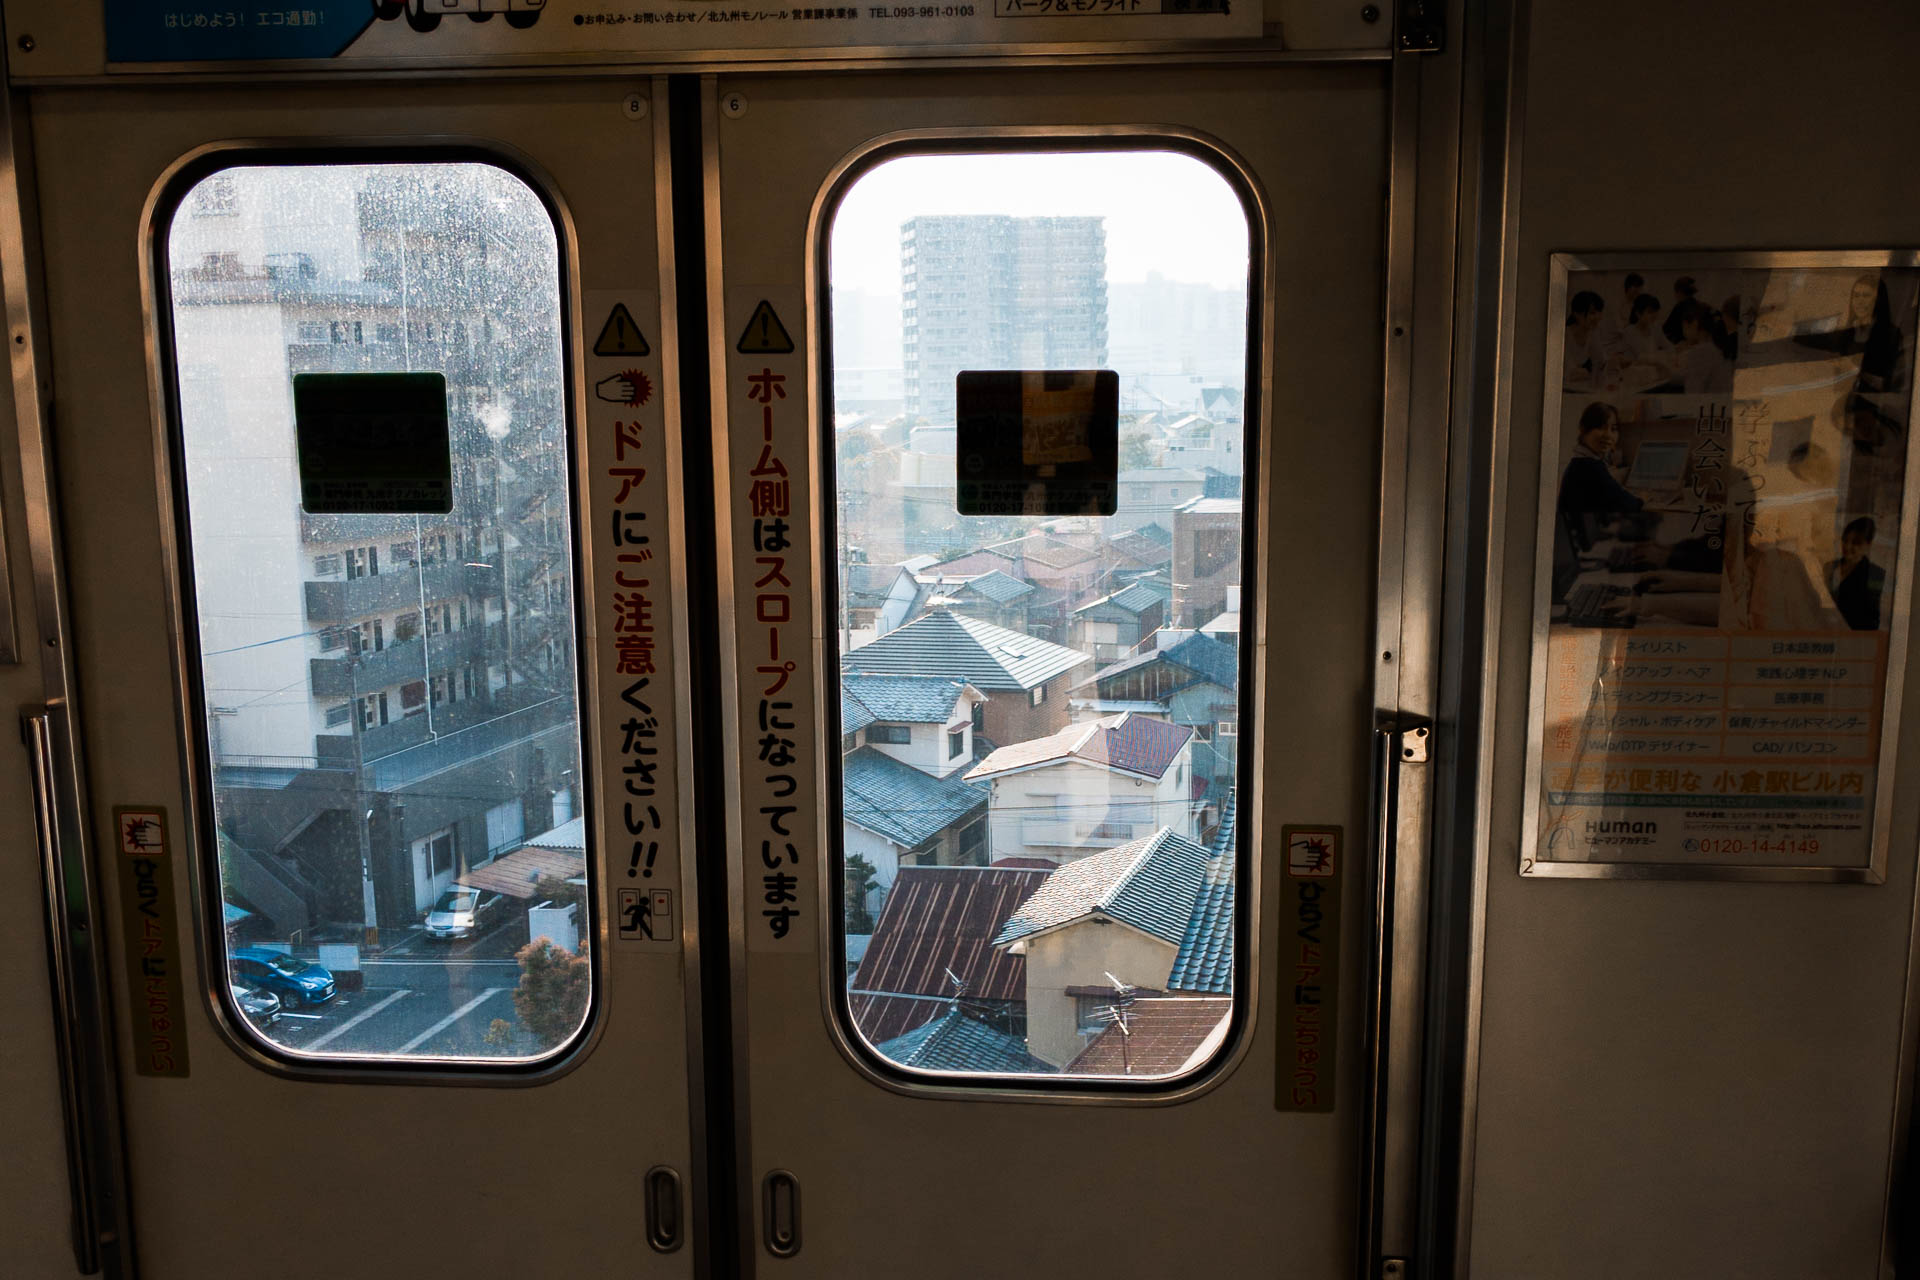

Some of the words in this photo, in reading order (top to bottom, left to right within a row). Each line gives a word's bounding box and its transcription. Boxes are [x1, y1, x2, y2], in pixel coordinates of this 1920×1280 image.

[164, 12, 245, 28] はじめよう！
[256, 10, 326, 26] エコ通勤！
[870, 6, 974, 18] TEL.093-961-0103
[730, 99, 740, 111] 6
[1691, 403, 1727, 550] 出会いだ。
[748, 367, 799, 940] ホーム側はスロープになっています
[1626, 641, 1688, 653] ネイリスト
[1772, 642, 1835, 655] 日本語教師
[1823, 667, 1848, 680] NLP
[1551, 768, 1702, 792] 通学が便利な
[1713, 770, 1864, 795] 小倉駅ビル内
[1585, 821, 1657, 834] Human
[1700, 838, 1819, 853] 0120-14-4149
[1523, 858, 1533, 874] 2
